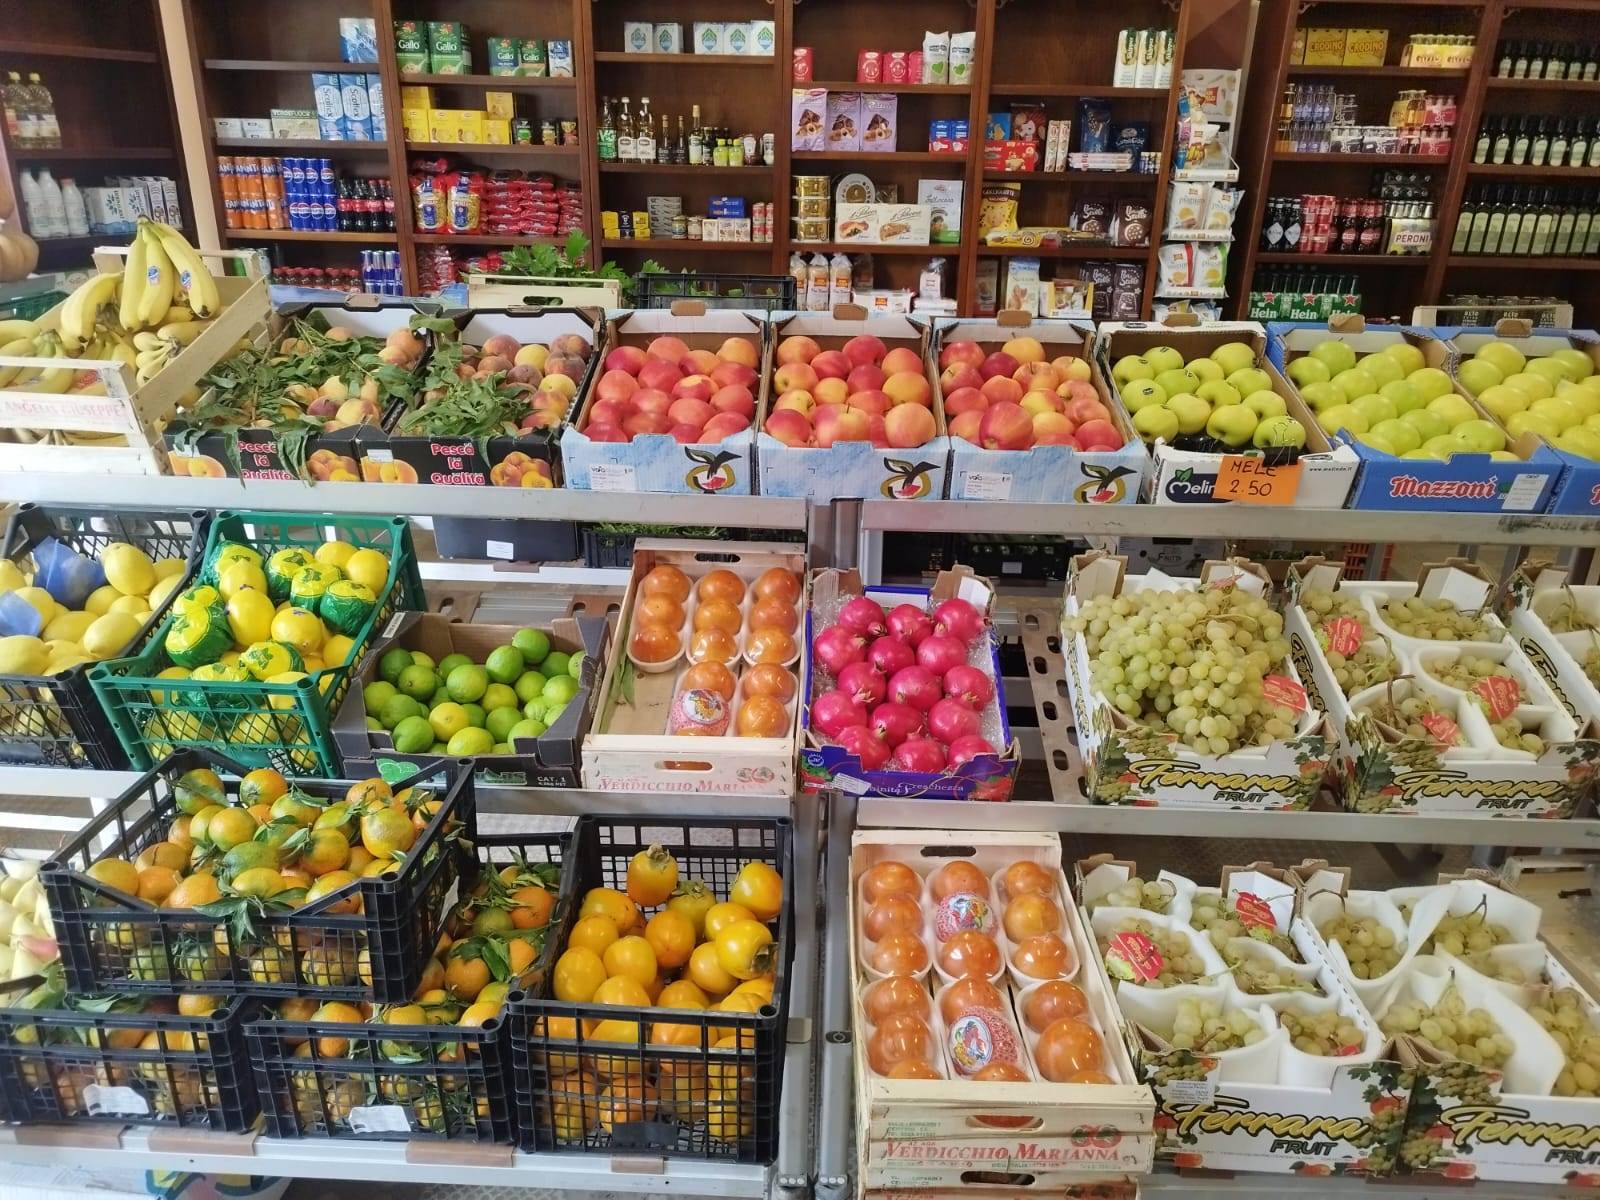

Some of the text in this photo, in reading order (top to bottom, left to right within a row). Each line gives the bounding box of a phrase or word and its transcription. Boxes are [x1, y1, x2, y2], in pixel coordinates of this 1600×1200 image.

[398, 39, 420, 50] Gallo
[436, 41, 457, 52] Gallo
[497, 52, 514, 61] Gallo
[523, 53, 540, 62] Gallo
[1395, 233, 1431, 245] PERONI
[1250, 308, 1278, 319] Hein
[1290, 309, 1318, 320] Hein
[431, 443, 475, 456] Pesca
[1231, 460, 1277, 477] MELE
[1230, 480, 1272, 497] 2.50
[1390, 474, 1498, 499] Mazzoni
[600, 778, 693, 792] VERDICCHIO
[1213, 791, 1269, 803] FRUIT
[1476, 798, 1535, 809] FRUIT
[886, 1137, 1120, 1160] VERDICCHIO MARIANNA
[1270, 1139, 1338, 1156] FRUIT
